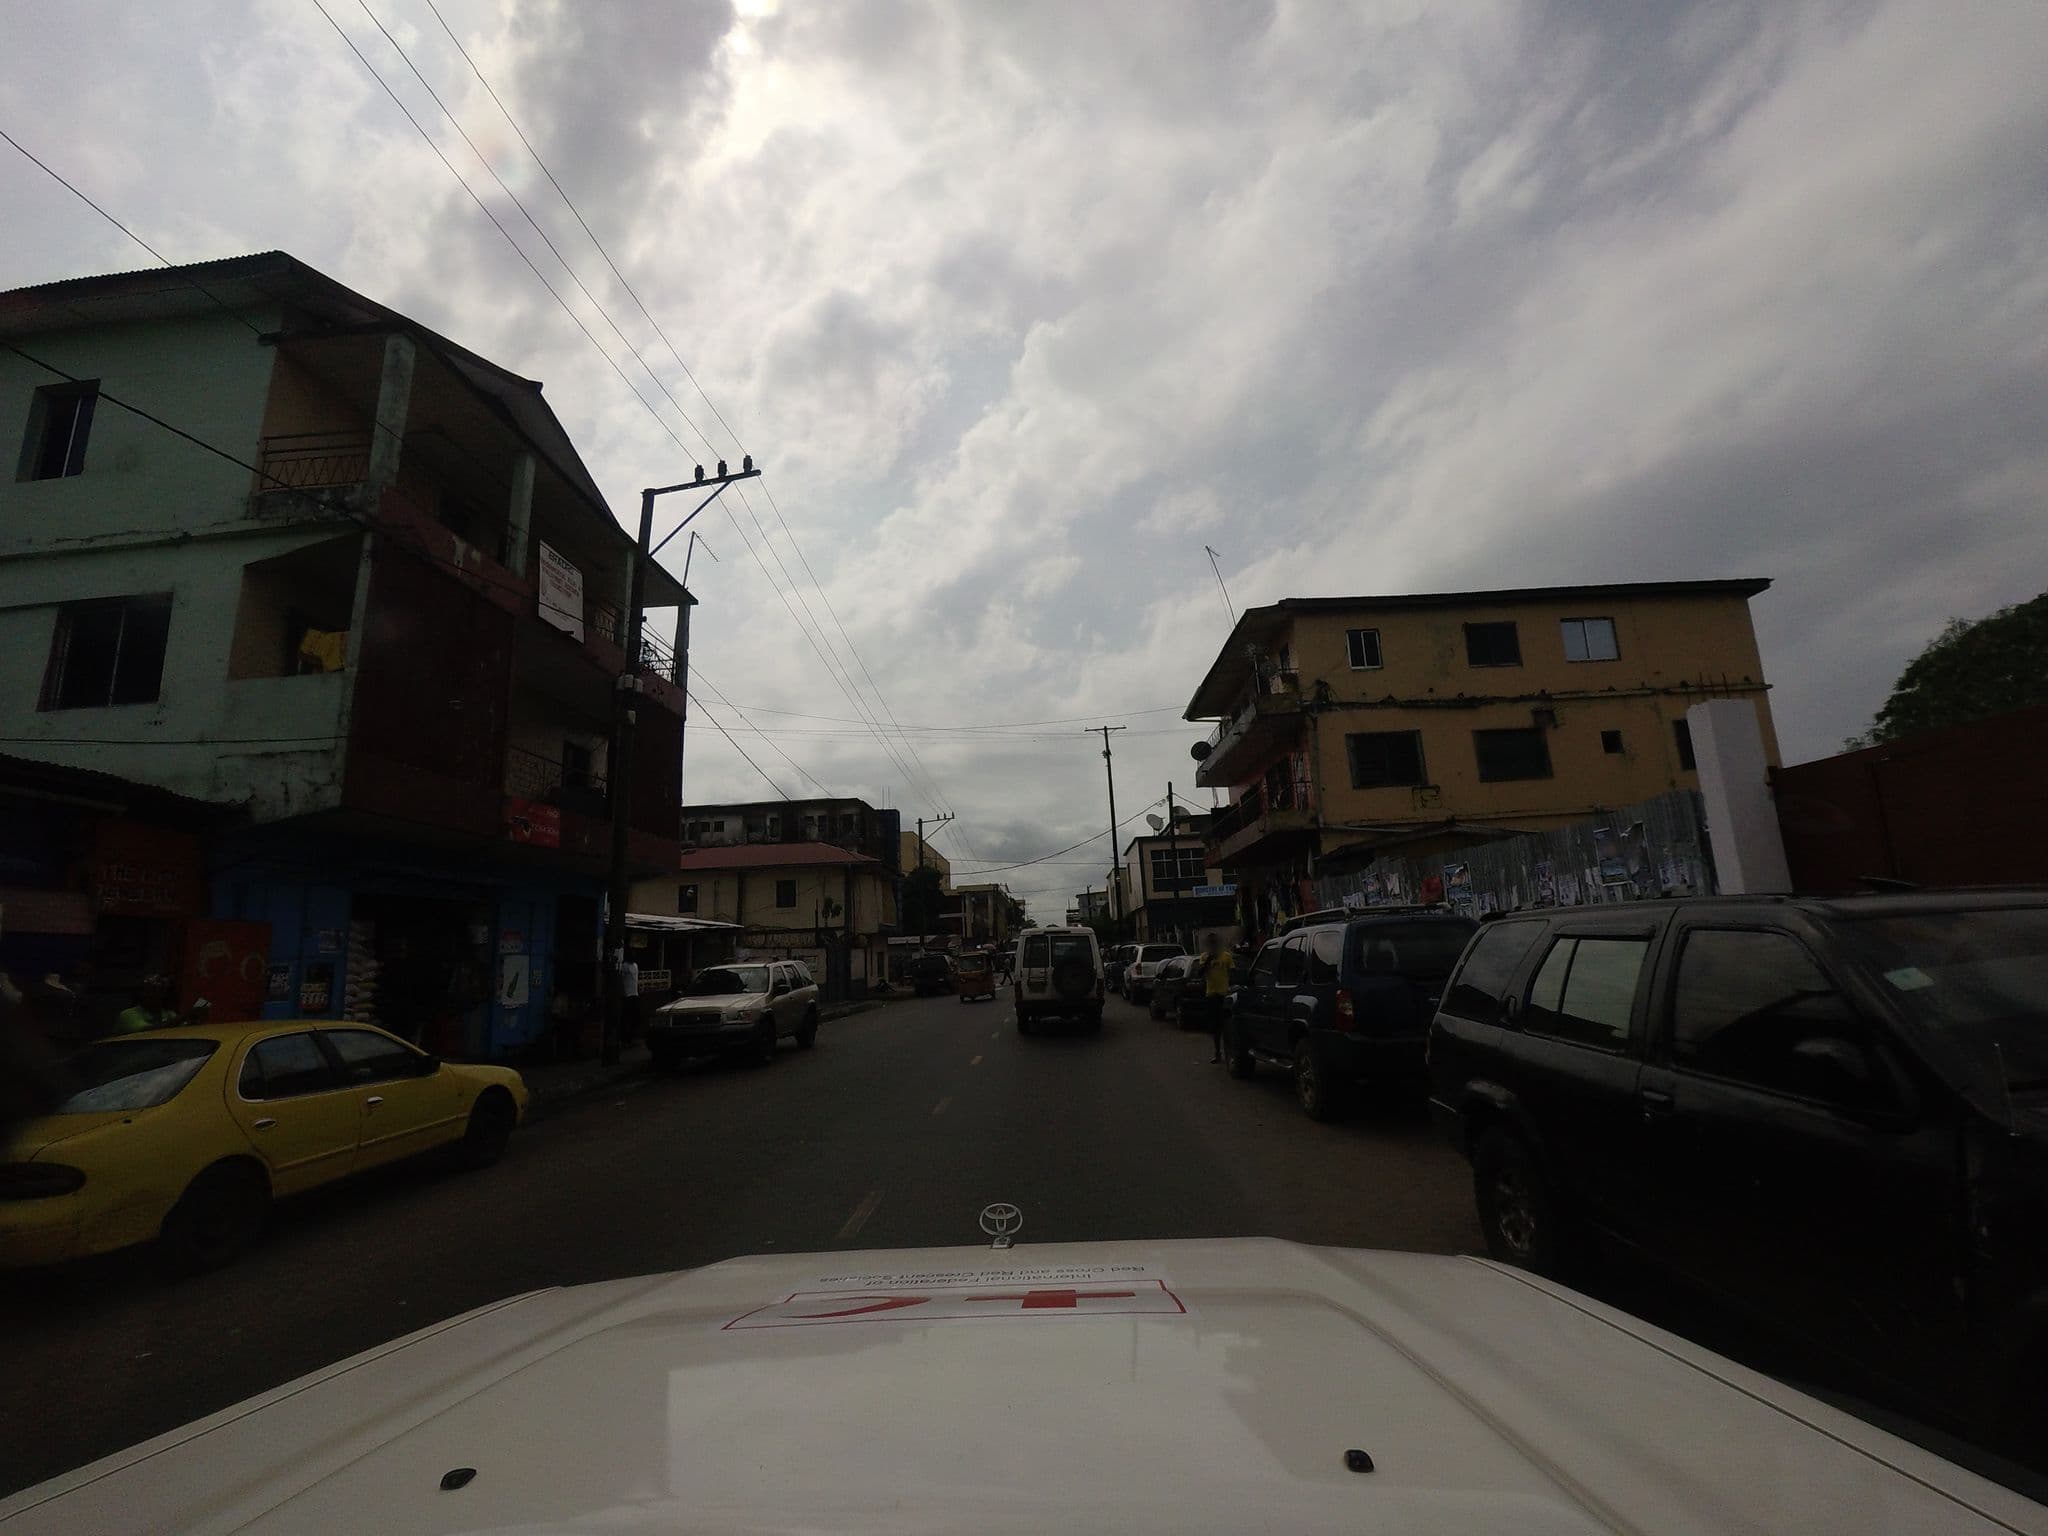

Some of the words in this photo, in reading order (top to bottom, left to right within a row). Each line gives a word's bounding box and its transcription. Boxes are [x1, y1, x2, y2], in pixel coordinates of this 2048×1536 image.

[820, 1275, 893, 1283] Societies
[889, 1277, 980, 1285] Federation
[987, 1274, 1091, 1282] International
